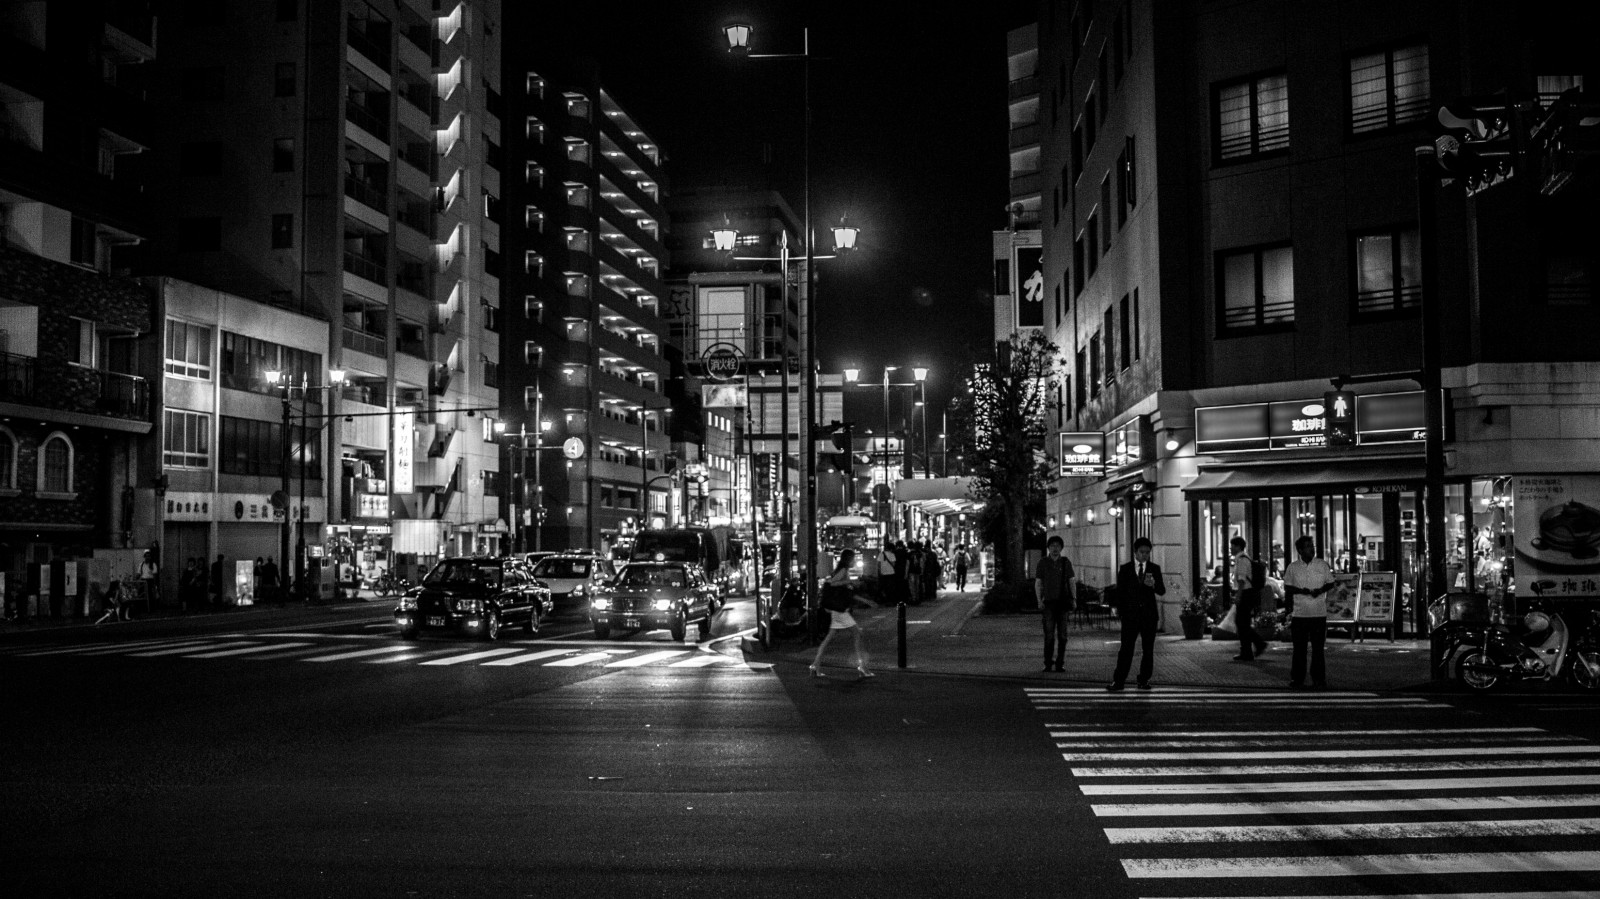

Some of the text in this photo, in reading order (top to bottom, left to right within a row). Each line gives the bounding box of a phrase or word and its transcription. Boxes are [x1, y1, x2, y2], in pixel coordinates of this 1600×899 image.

[710, 357, 737, 371] 消火栓
[1064, 453, 1101, 464] 珈琲館
